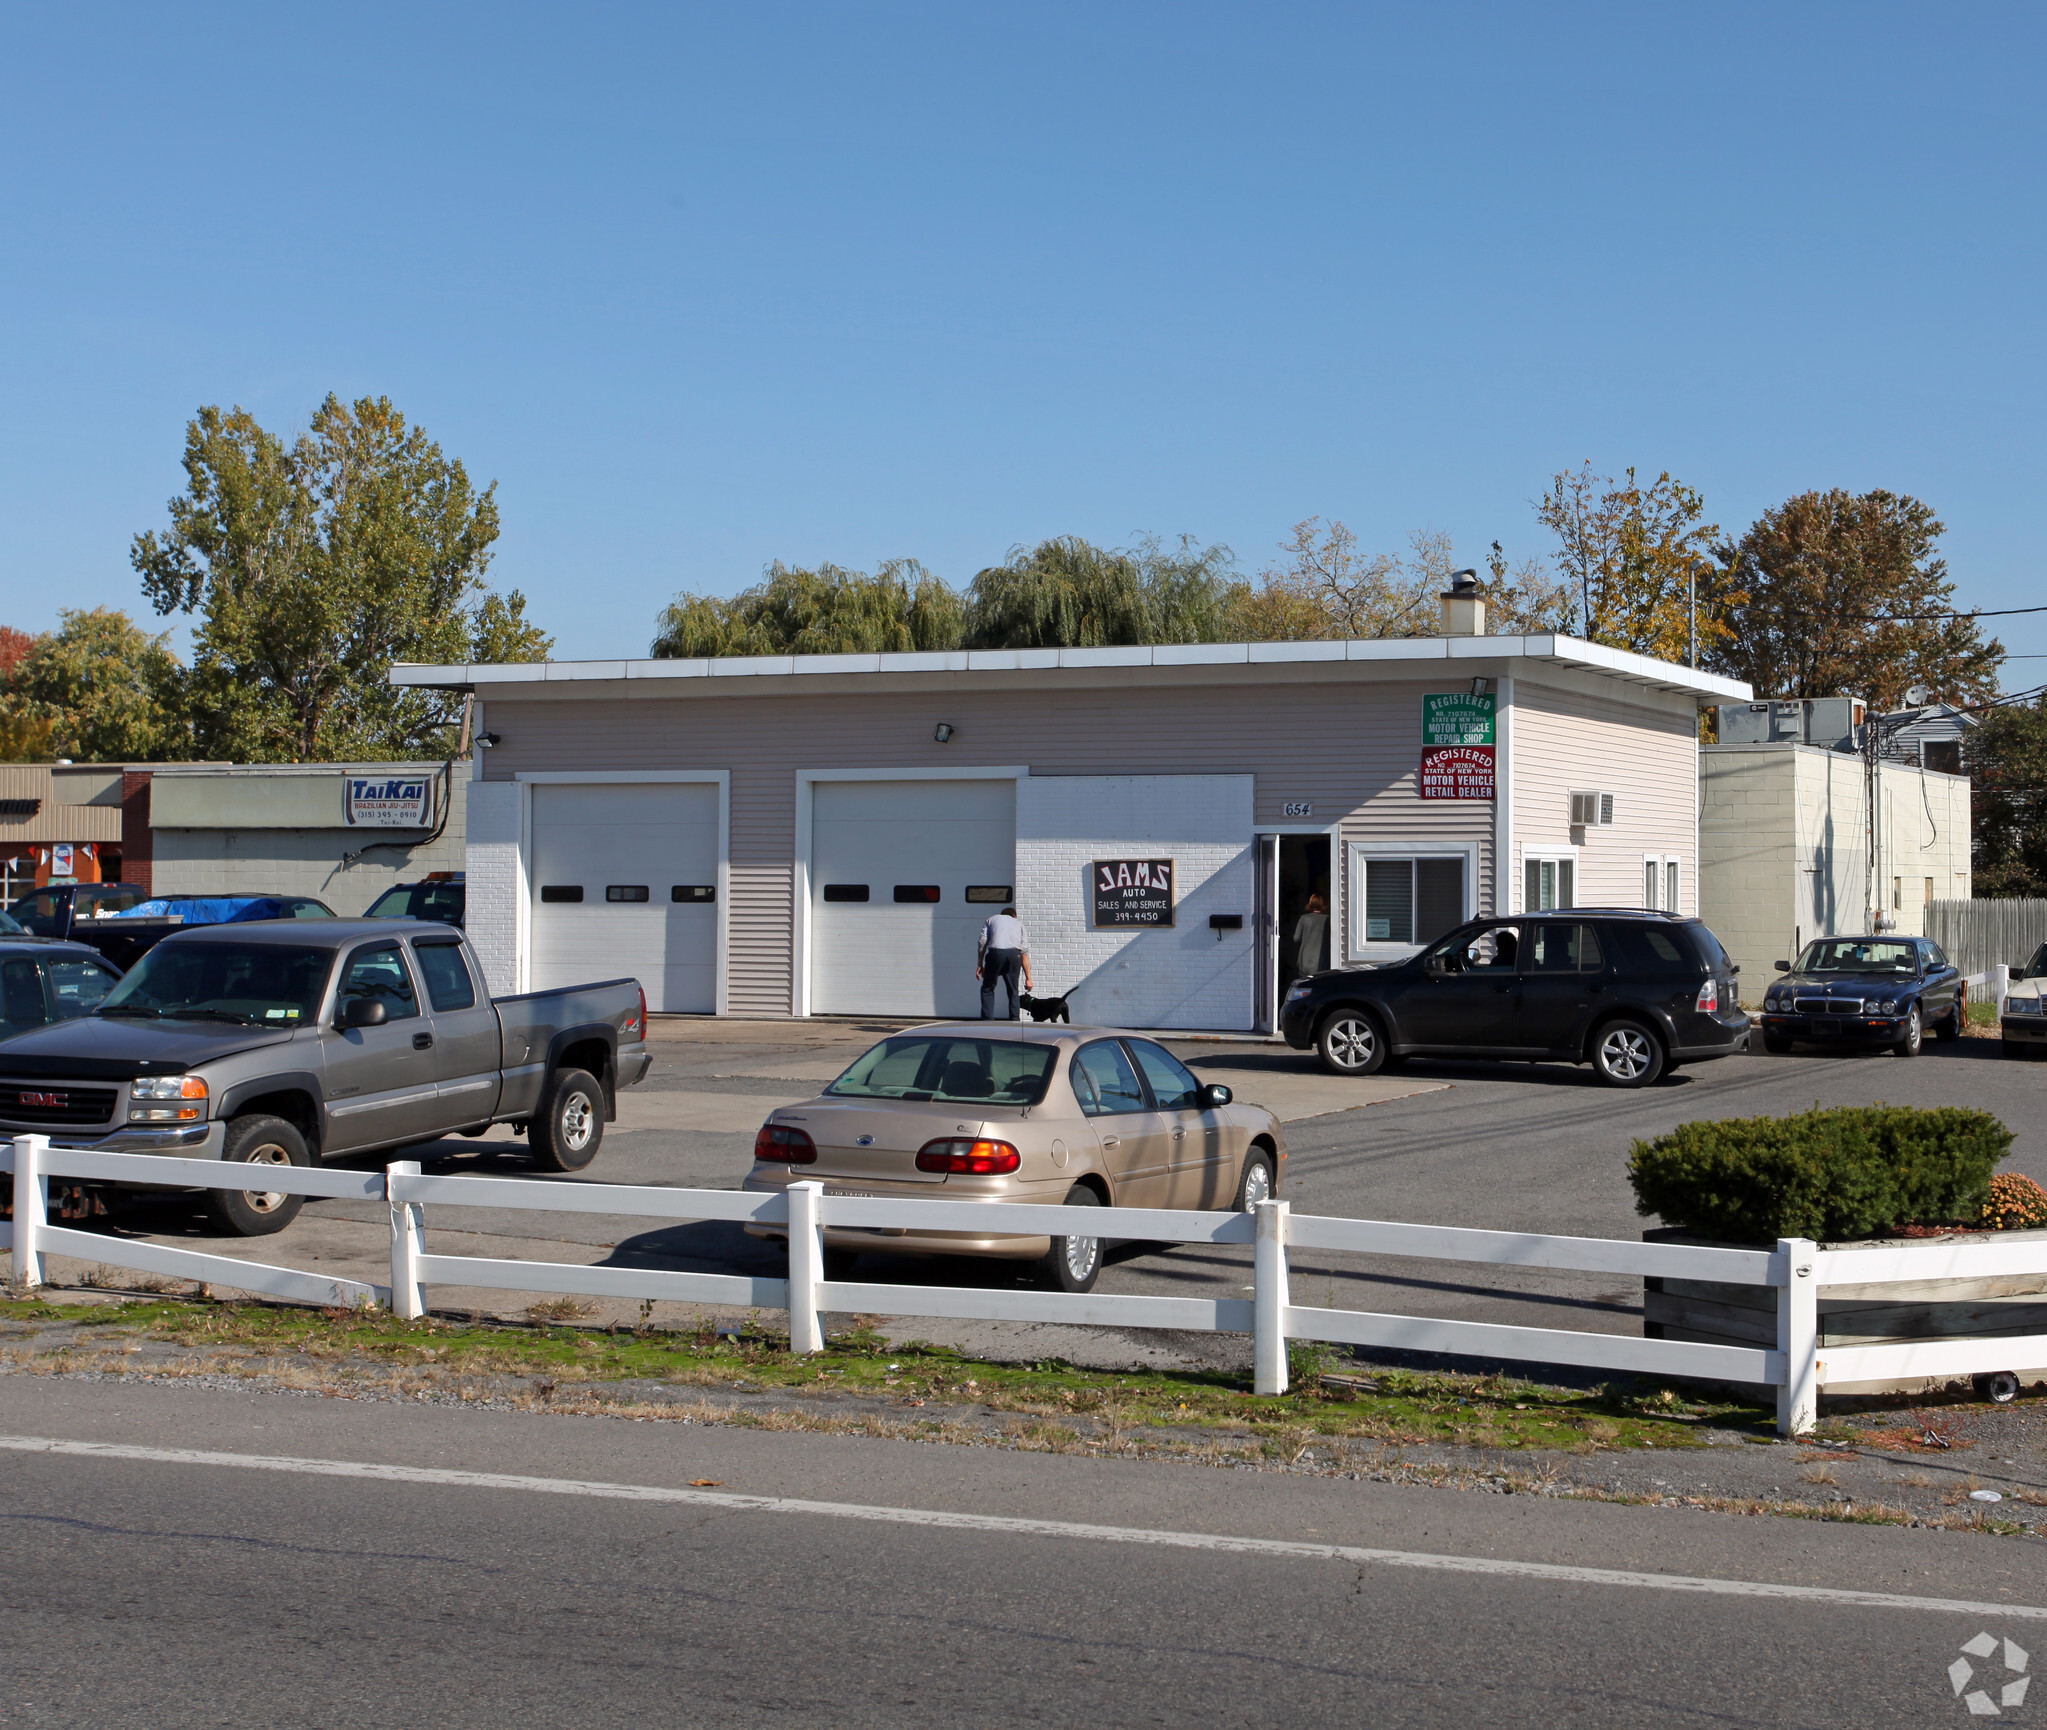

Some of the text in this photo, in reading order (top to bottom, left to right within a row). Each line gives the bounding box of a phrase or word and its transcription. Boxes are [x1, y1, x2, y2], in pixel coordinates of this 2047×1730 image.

[1430, 694, 1491, 710] REGISTERED
[1428, 723, 1490, 733] MOTOR VEHICLE
[1434, 734, 1484, 744] REPAIR SHOP
[1425, 748, 1493, 767] REGISTERED
[1423, 775, 1494, 786] MOTOR VEHICLE
[1425, 787, 1492, 797] RETAIL DEALER
[357, 810, 375, 819] (315)
[1285, 803, 1310, 816] 654
[1098, 862, 1170, 892] JAMS
[1122, 888, 1146, 898] AUTO
[1098, 900, 1167, 910] SALES AND SERVICE
[1114, 912, 1159, 921] 399-4450
[20, 1091, 68, 1107] GMC
